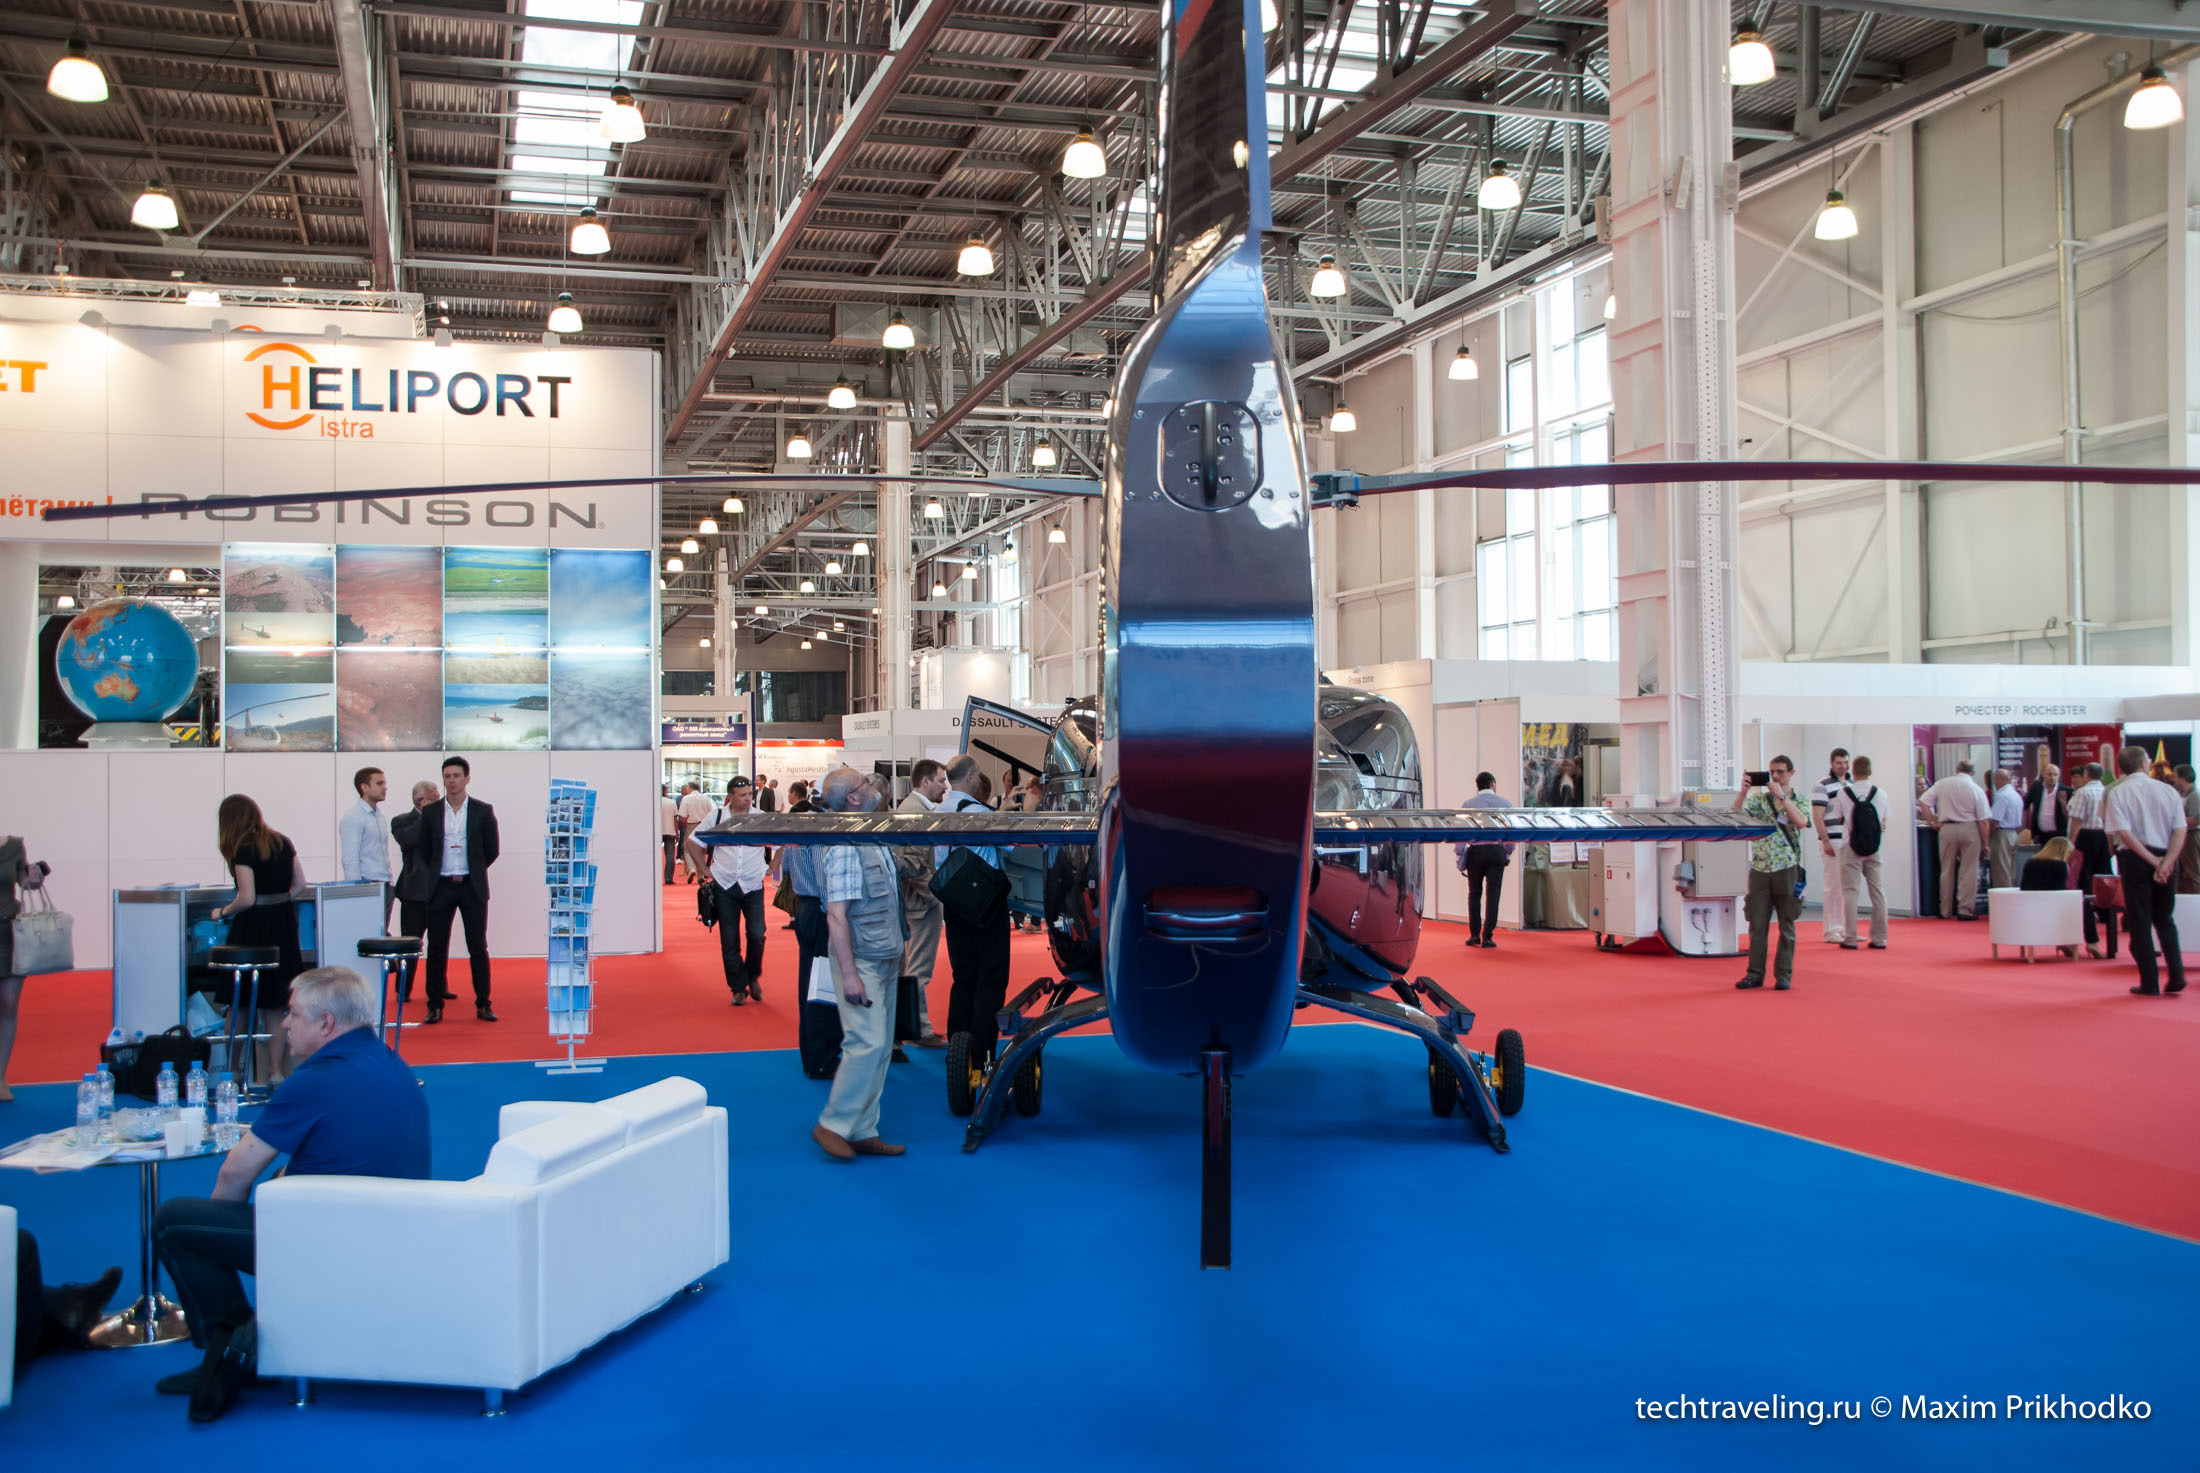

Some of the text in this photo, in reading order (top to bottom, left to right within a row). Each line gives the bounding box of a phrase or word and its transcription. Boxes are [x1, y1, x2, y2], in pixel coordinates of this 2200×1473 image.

[262, 364, 572, 419] HELIPORT
[320, 415, 374, 439] Istra
[1955, 704, 2012, 716] РОЧЕСТЕР
[2022, 704, 2087, 716] ROCHESTER
[952, 717, 1015, 728] DSSAULT
